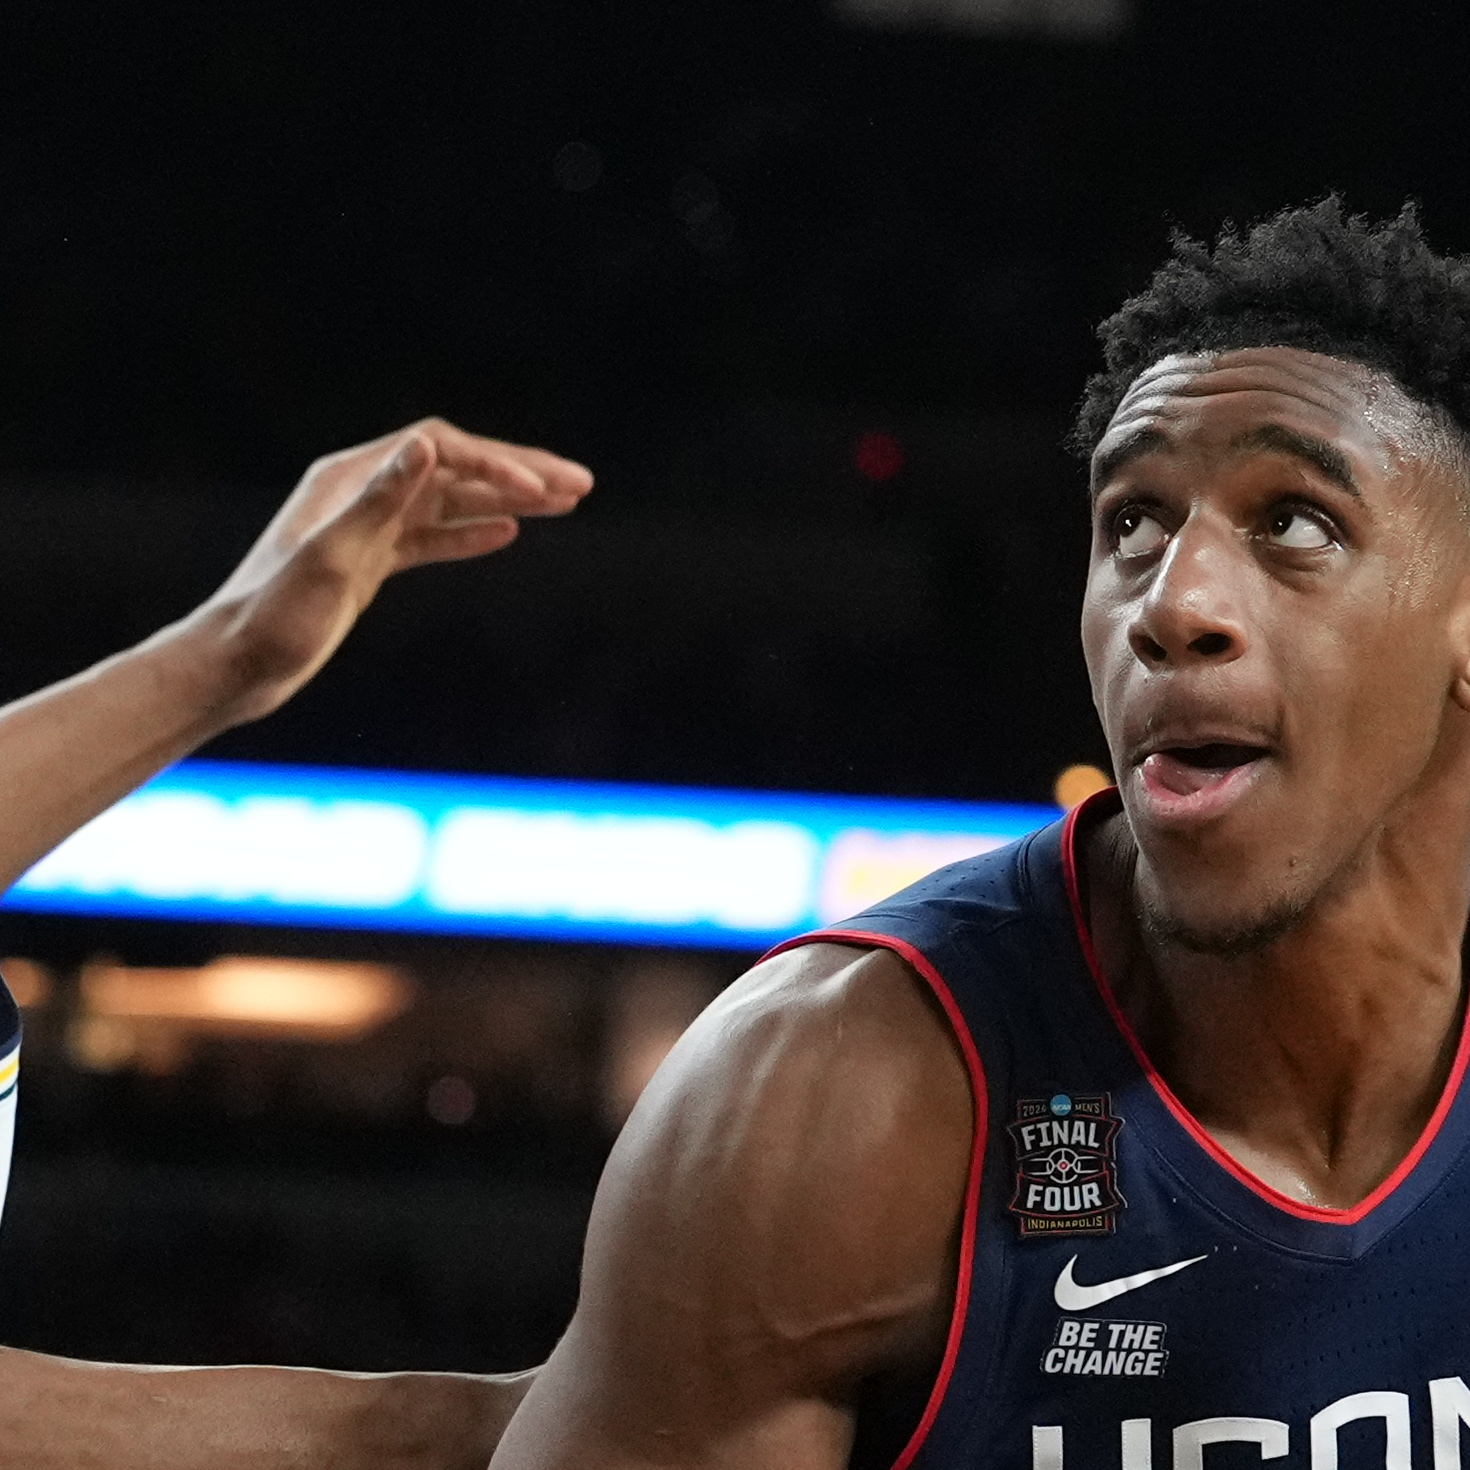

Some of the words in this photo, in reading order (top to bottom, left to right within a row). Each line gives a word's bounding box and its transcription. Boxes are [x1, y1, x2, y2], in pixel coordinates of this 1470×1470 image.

[1020, 1120, 1101, 1151] FINAL
[1026, 1181, 1103, 1212] FOUR
[1027, 1215, 1103, 1230] INDIANAPOLIS
[1058, 1321, 1100, 1348] BE
[1108, 1323, 1163, 1350] THE
[1044, 1348, 1164, 1376] CHANGE
